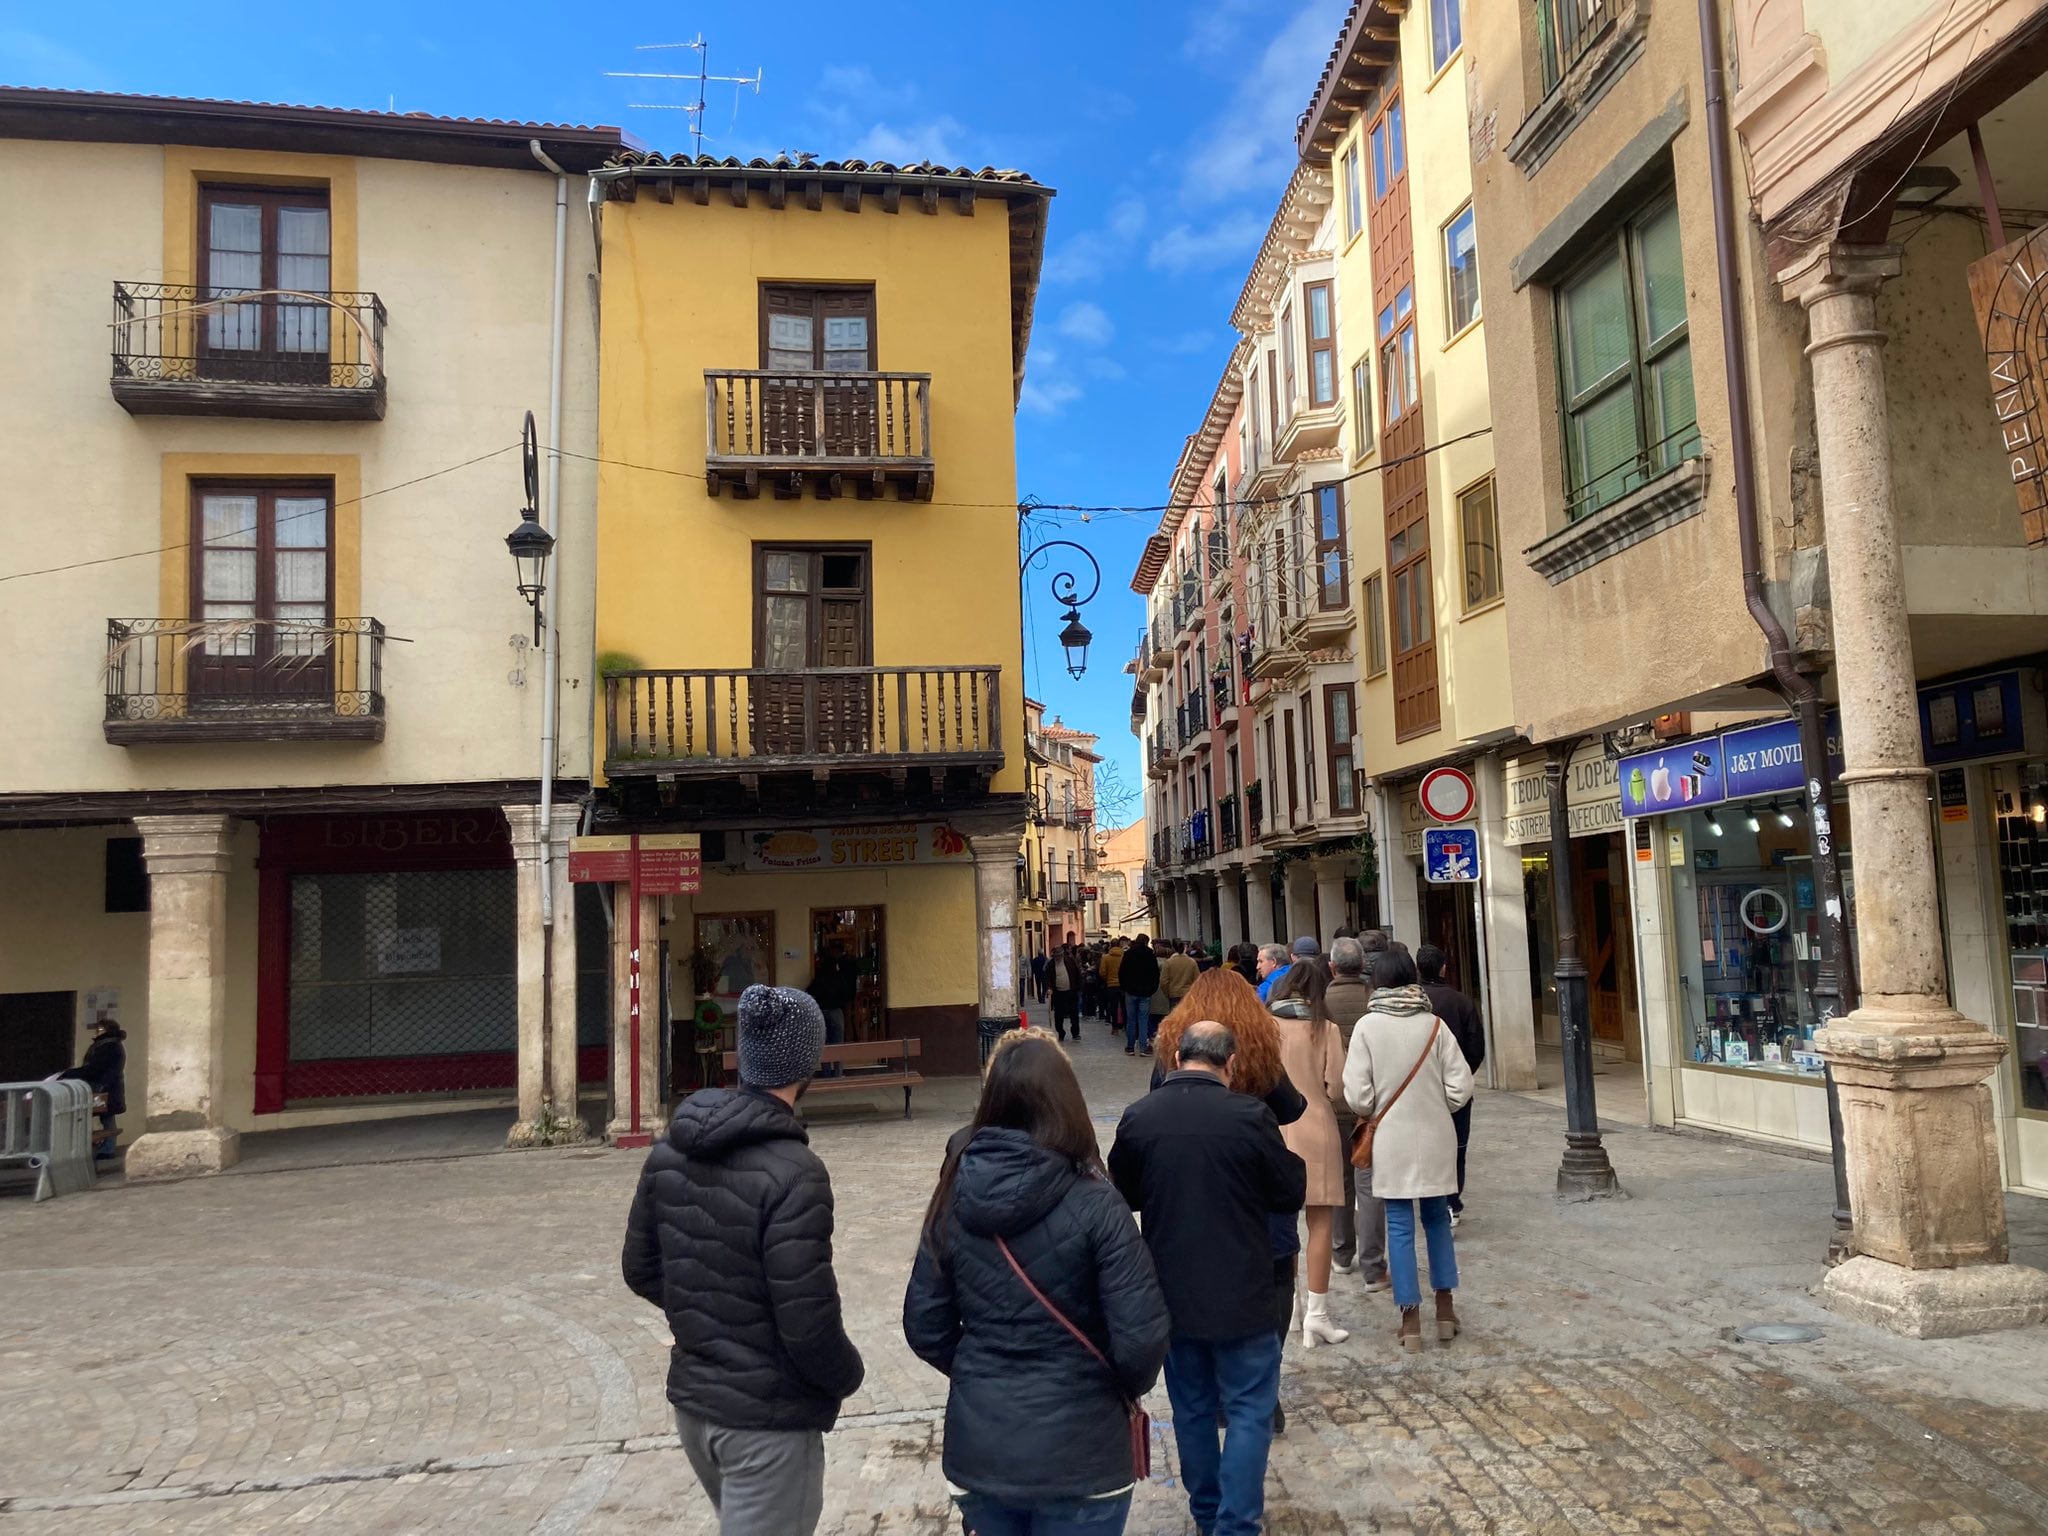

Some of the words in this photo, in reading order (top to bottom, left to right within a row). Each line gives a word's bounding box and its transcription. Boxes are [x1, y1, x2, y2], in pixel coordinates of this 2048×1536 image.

[1731, 751, 1757, 774] J&Y
[1511, 775, 1549, 804] TEODO
[762, 856, 795, 867] Patatas
[796, 856, 821, 867] Fritas
[831, 837, 918, 864] STREET
